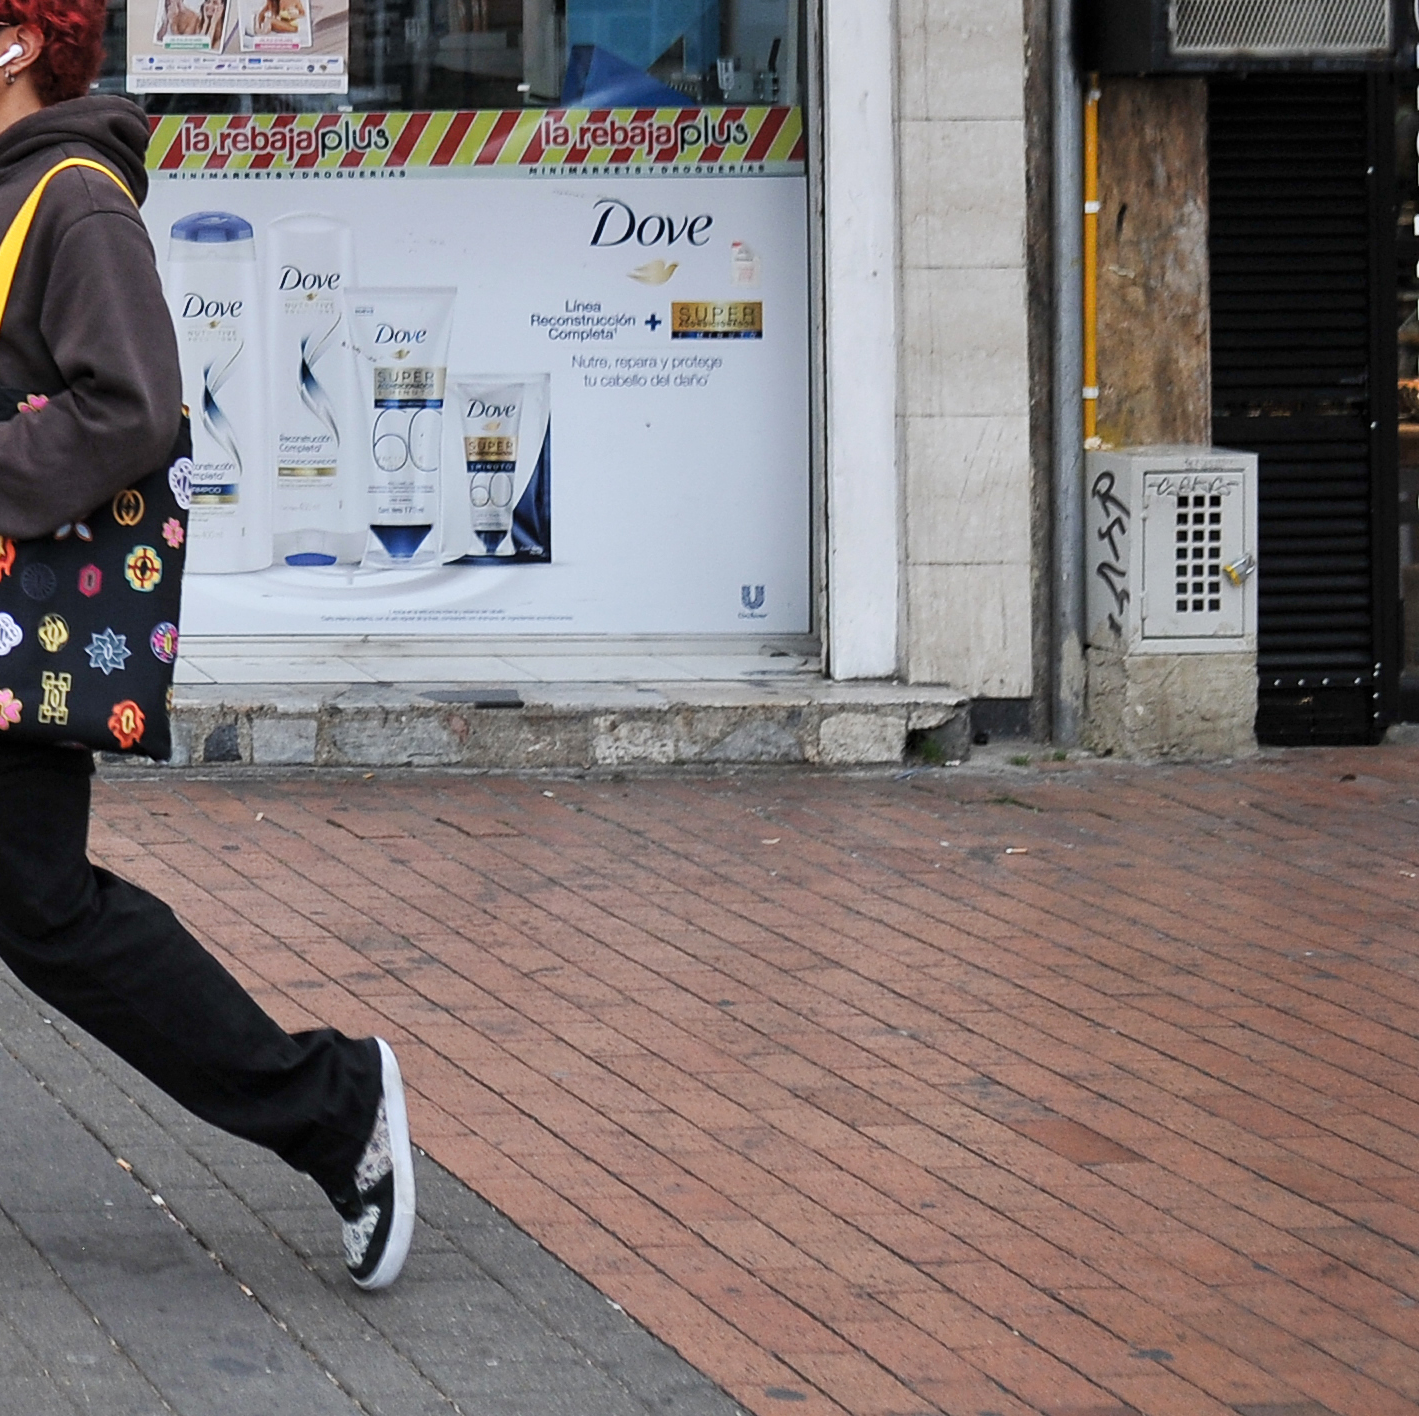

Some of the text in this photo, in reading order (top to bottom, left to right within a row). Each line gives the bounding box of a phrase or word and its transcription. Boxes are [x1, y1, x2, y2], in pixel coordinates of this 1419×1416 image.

[183, 121, 390, 161] la rebaja plus
[542, 114, 749, 155] la rebaja plus
[590, 198, 713, 247] Dove
[278, 265, 341, 290] Dove
[182, 292, 243, 318] Dove
[565, 300, 601, 313] Línea
[679, 306, 756, 323] SUPER
[531, 313, 636, 328] Reconstrucción
[374, 323, 427, 344] Dove
[572, 355, 722, 372] Nutre, repara y protege
[377, 371, 435, 383] SUPER
[584, 375, 597, 387] tu
[600, 373, 647, 387] cabello
[650, 373, 670, 387] del
[467, 398, 516, 418] Dove
[469, 441, 513, 451] SUPER
[469, 471, 513, 508] 60
